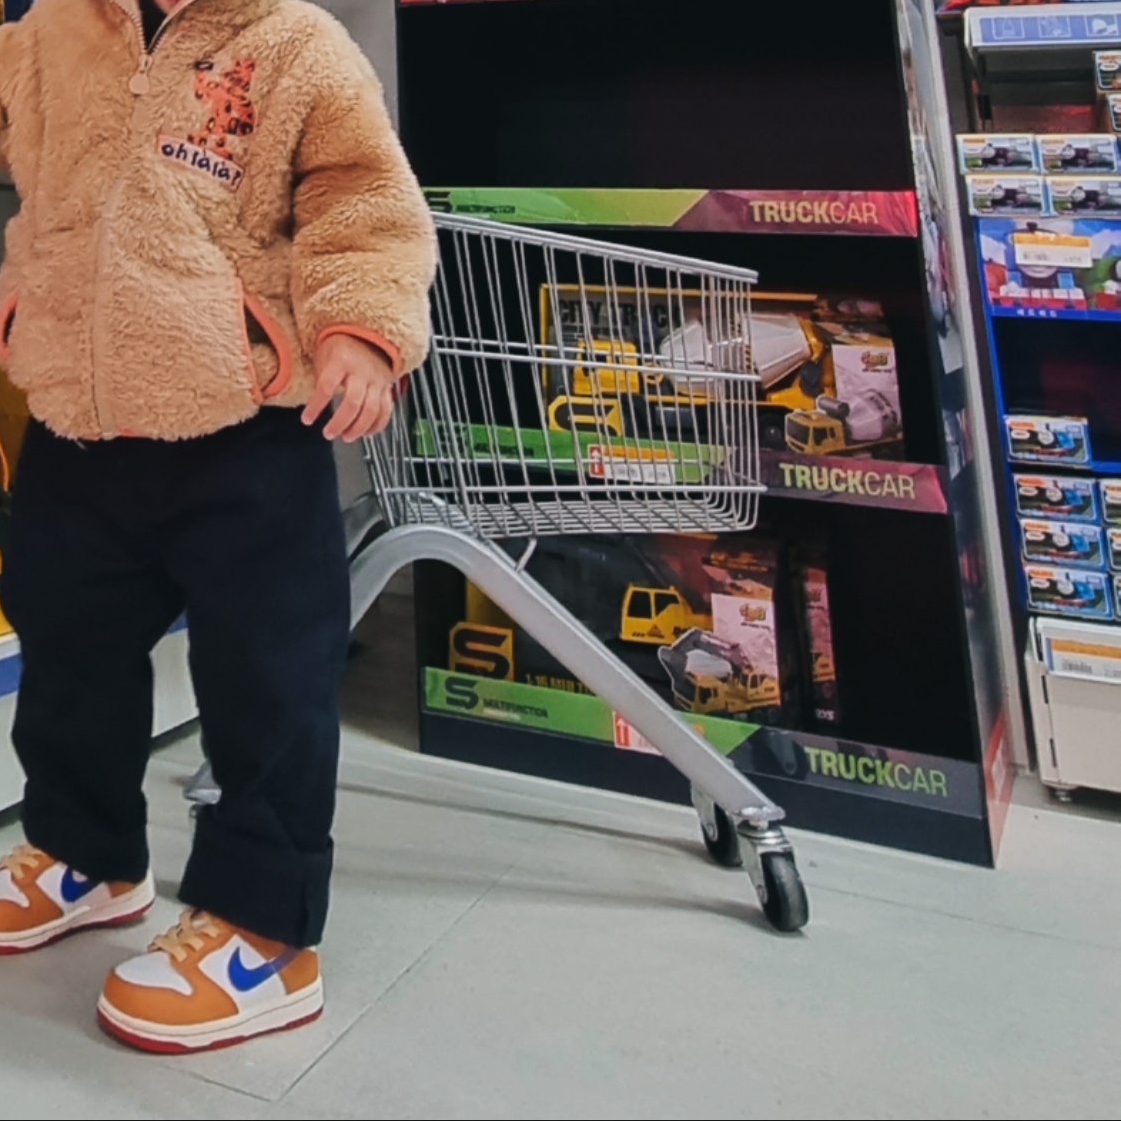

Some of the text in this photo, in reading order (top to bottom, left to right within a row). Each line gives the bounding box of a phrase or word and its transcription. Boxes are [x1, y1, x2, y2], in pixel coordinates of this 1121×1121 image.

[749, 200, 878, 225] TRUCKCAR
[780, 463, 916, 501] TRUCKCAR
[805, 746, 949, 799] TRUCKCAR
